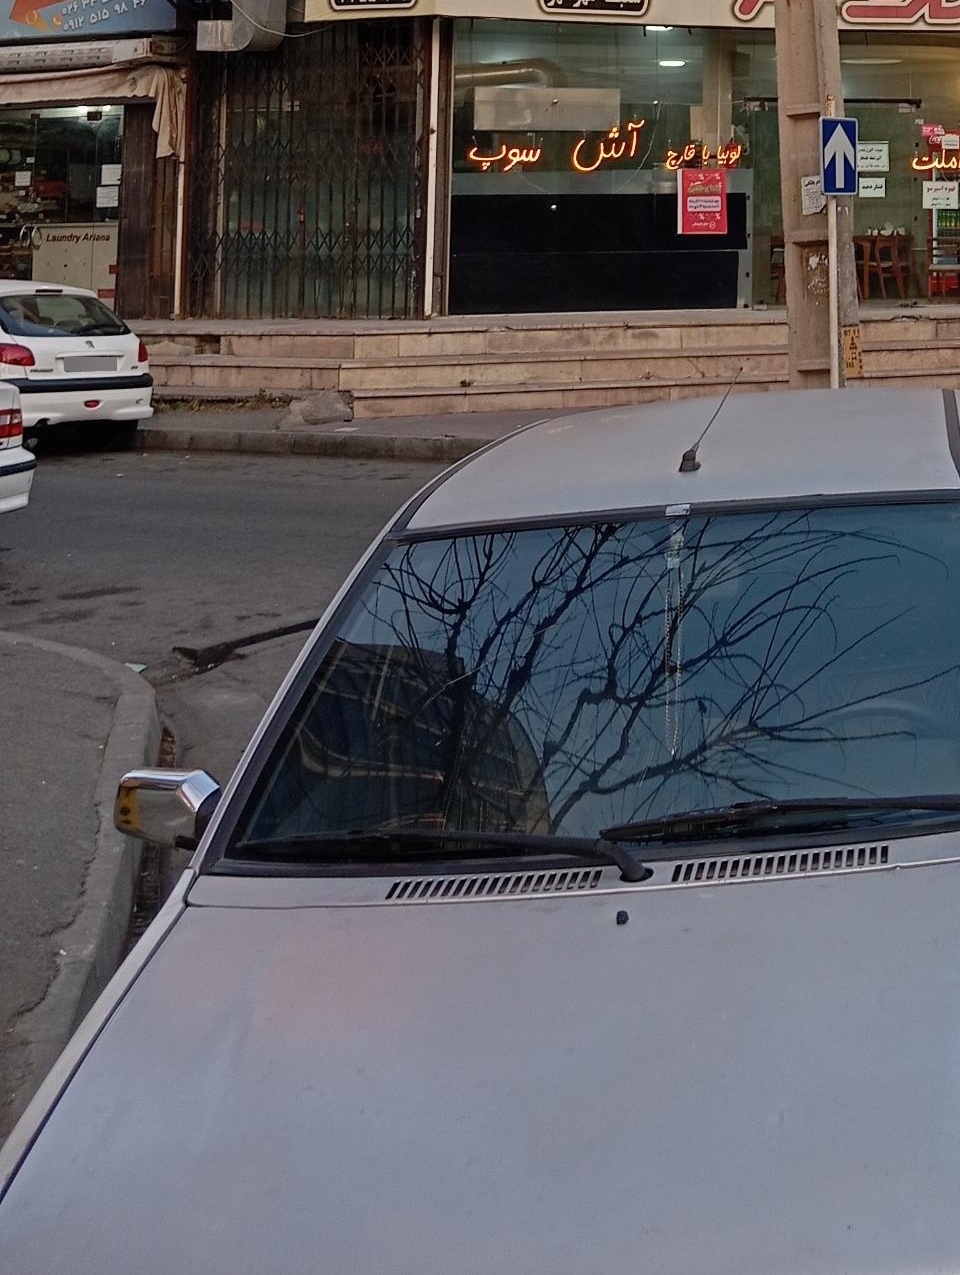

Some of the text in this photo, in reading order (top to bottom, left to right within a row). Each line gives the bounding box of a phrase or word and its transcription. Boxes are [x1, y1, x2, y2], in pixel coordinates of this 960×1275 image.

[468, 144, 542, 171] سوپ
[573, 119, 645, 172] آش
[666, 144, 742, 170] لوبیا با قارچ
[46, 232, 110, 243] Laundry Ariana
